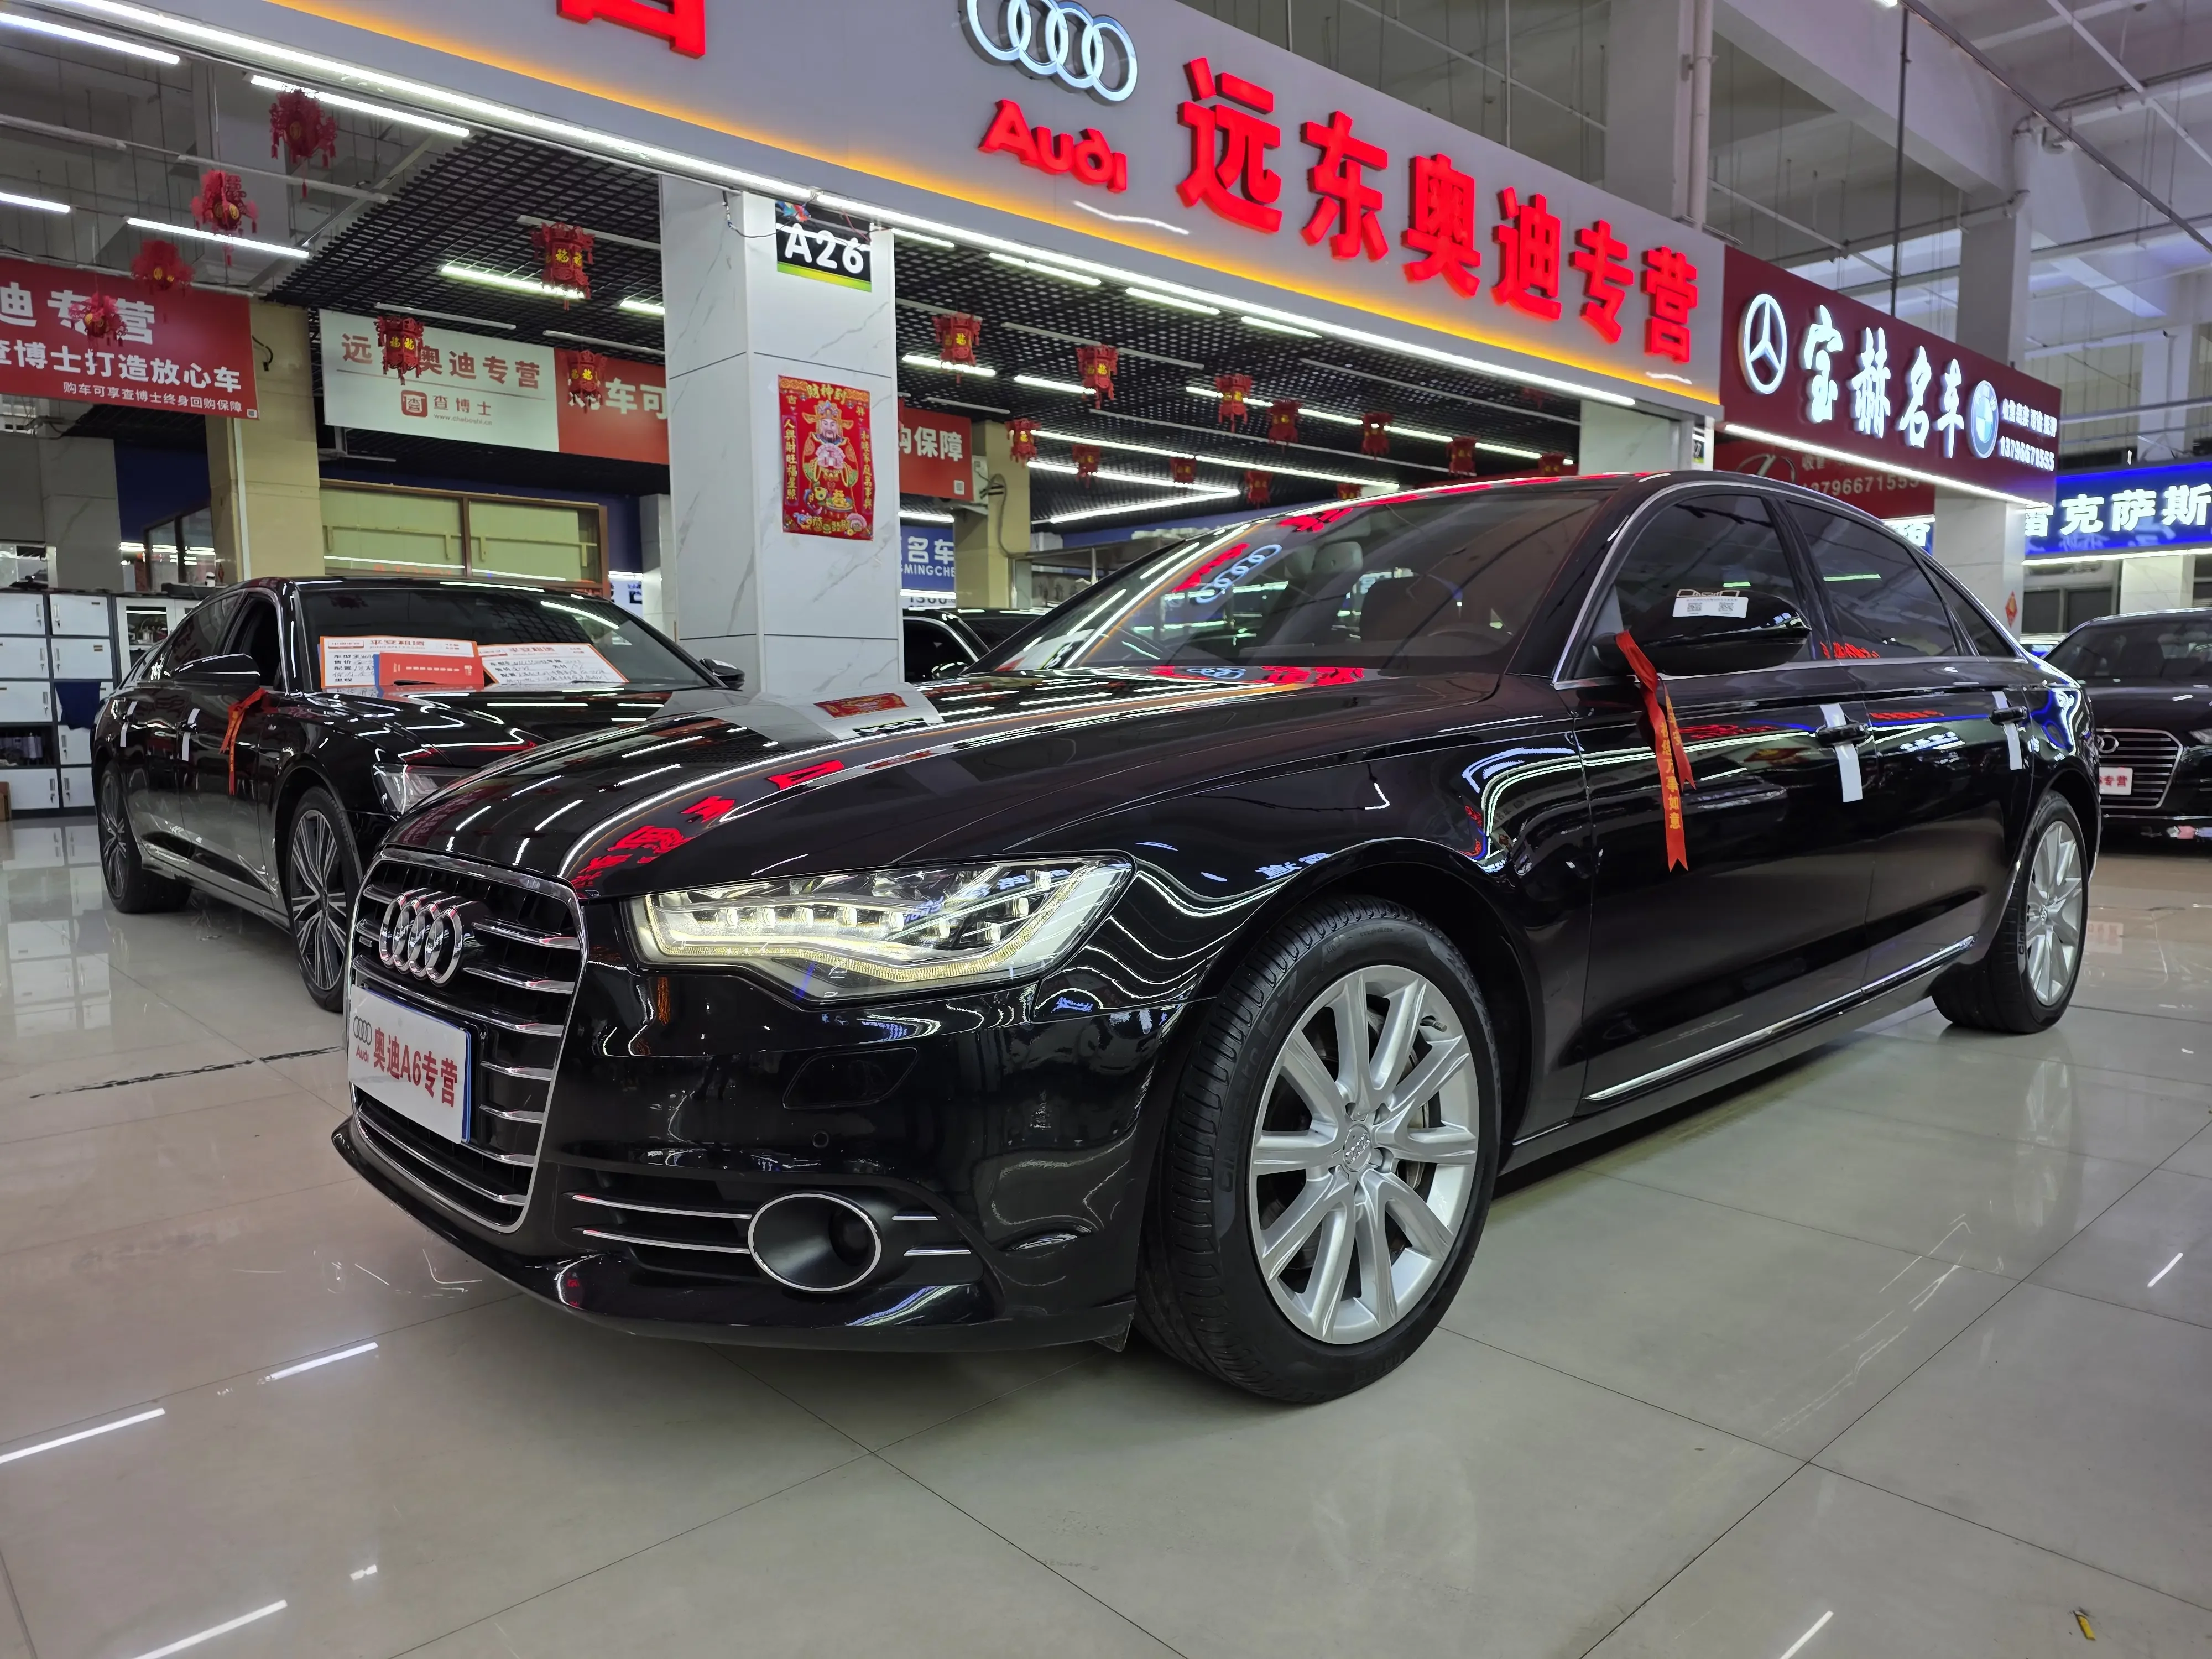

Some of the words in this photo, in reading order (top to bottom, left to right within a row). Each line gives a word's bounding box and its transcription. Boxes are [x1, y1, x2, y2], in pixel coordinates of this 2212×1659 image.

[978, 100, 1127, 193] Audi
[1176, 57, 1698, 363] 远东奥迪专营
[784, 223, 864, 274] A26
[342, 333, 540, 390] 远奥迪专营
[1801, 305, 1965, 458] 宝赫名车
[64, 382, 243, 413] 购车可享查博士终身回购保障
[432, 395, 492, 416] 查博士
[2000, 436, 2055, 472] 13796671555
[900, 536, 956, 565] 名车
[373, 1026, 458, 1108] 奥迪A6专营
